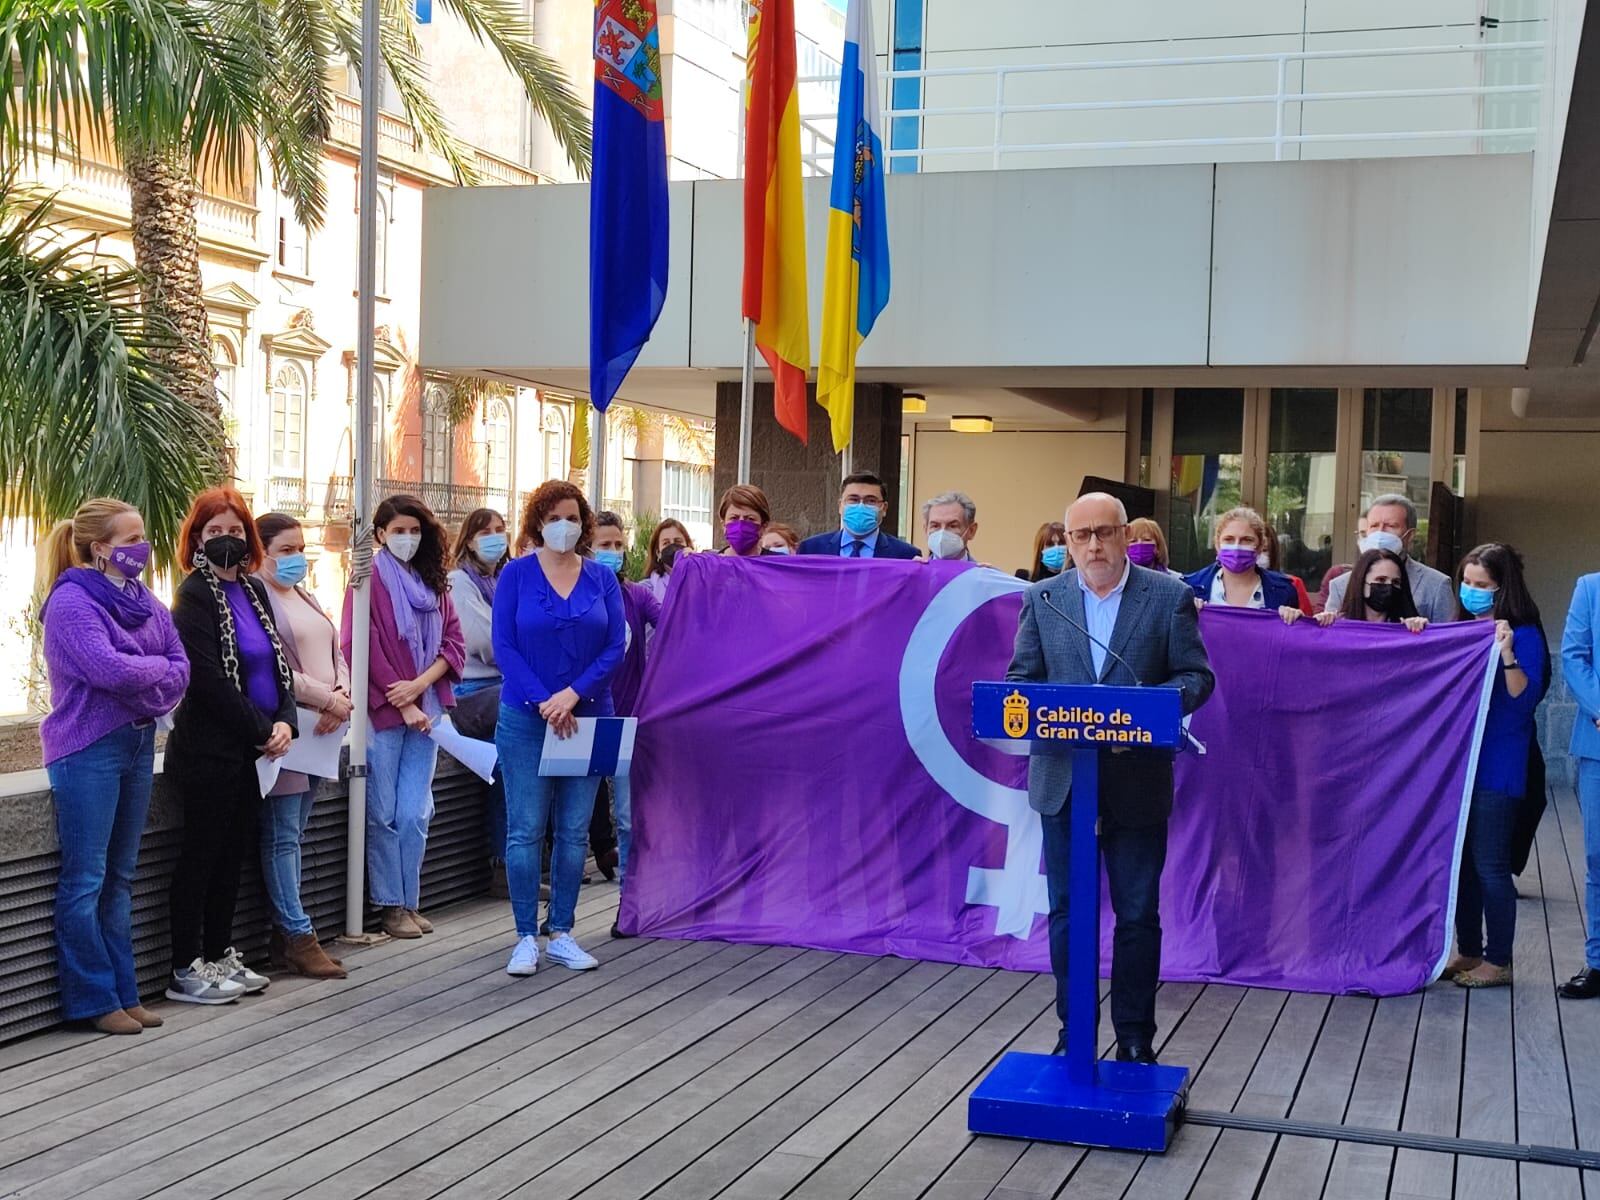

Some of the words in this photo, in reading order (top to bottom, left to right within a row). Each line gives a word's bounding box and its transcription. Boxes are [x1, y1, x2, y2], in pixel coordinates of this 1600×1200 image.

[1036, 706, 1105, 723] Cabildo
[1109, 709, 1132, 725] de
[1036, 723, 1079, 739] Gran
[1083, 725, 1152, 743] Canaria
